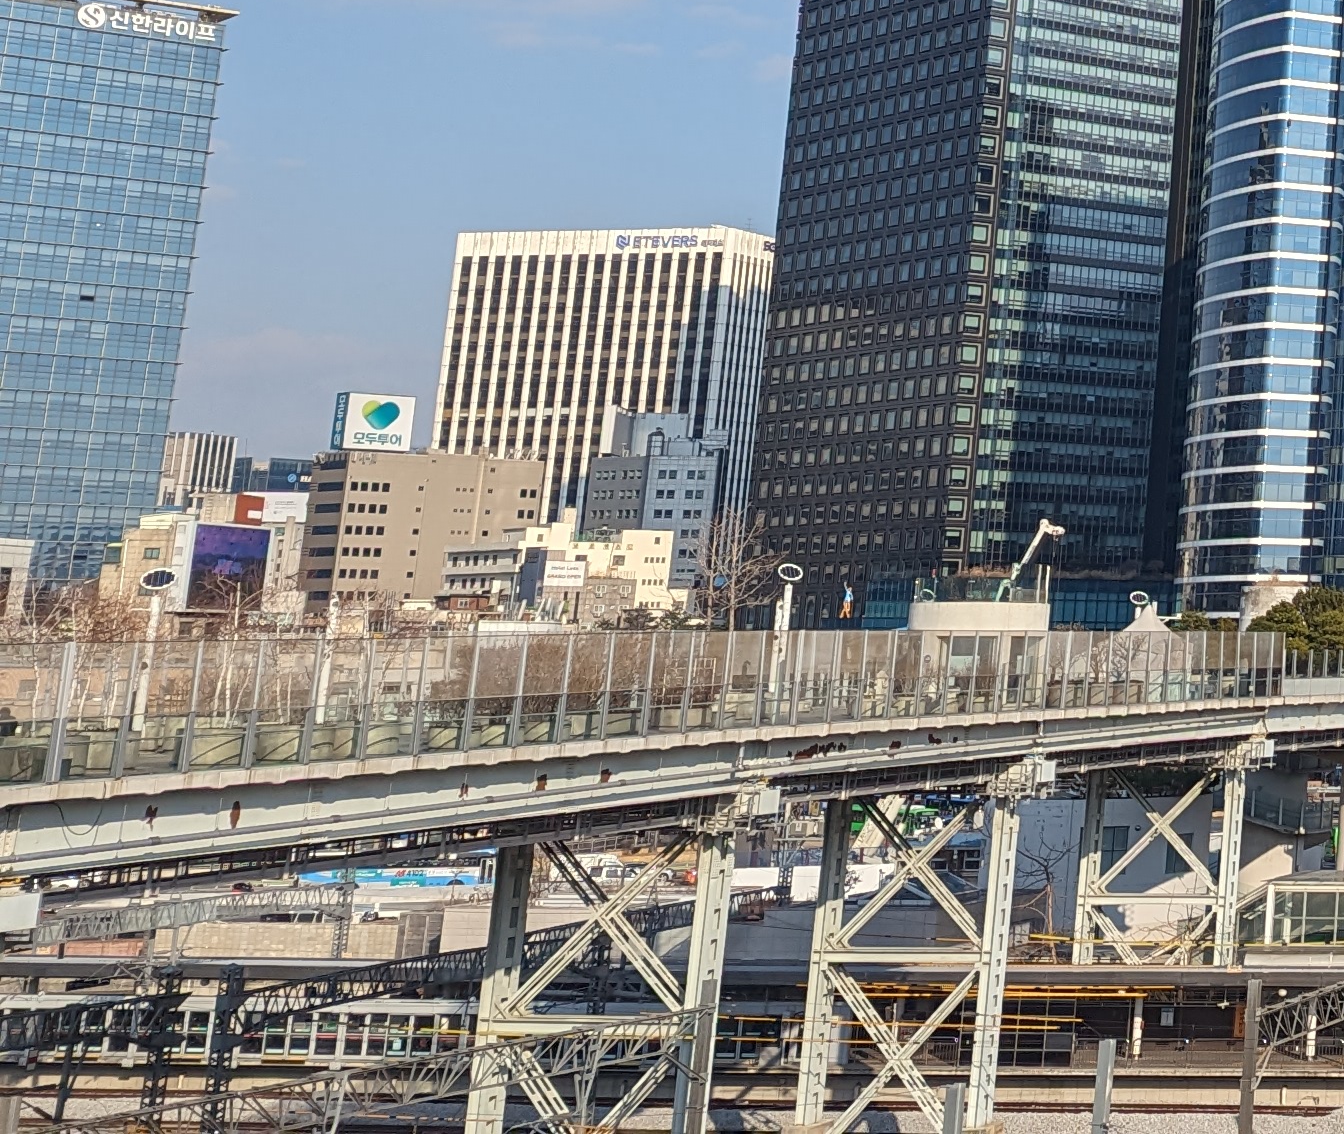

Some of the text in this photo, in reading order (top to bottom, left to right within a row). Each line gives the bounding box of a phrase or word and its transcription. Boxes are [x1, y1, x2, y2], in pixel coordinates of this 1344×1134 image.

[109, 11, 216, 42] 신한라이프
[632, 235, 699, 249] ETEVERS
[333, 394, 347, 446] 모두투어
[352, 431, 403, 446] 모두투어
